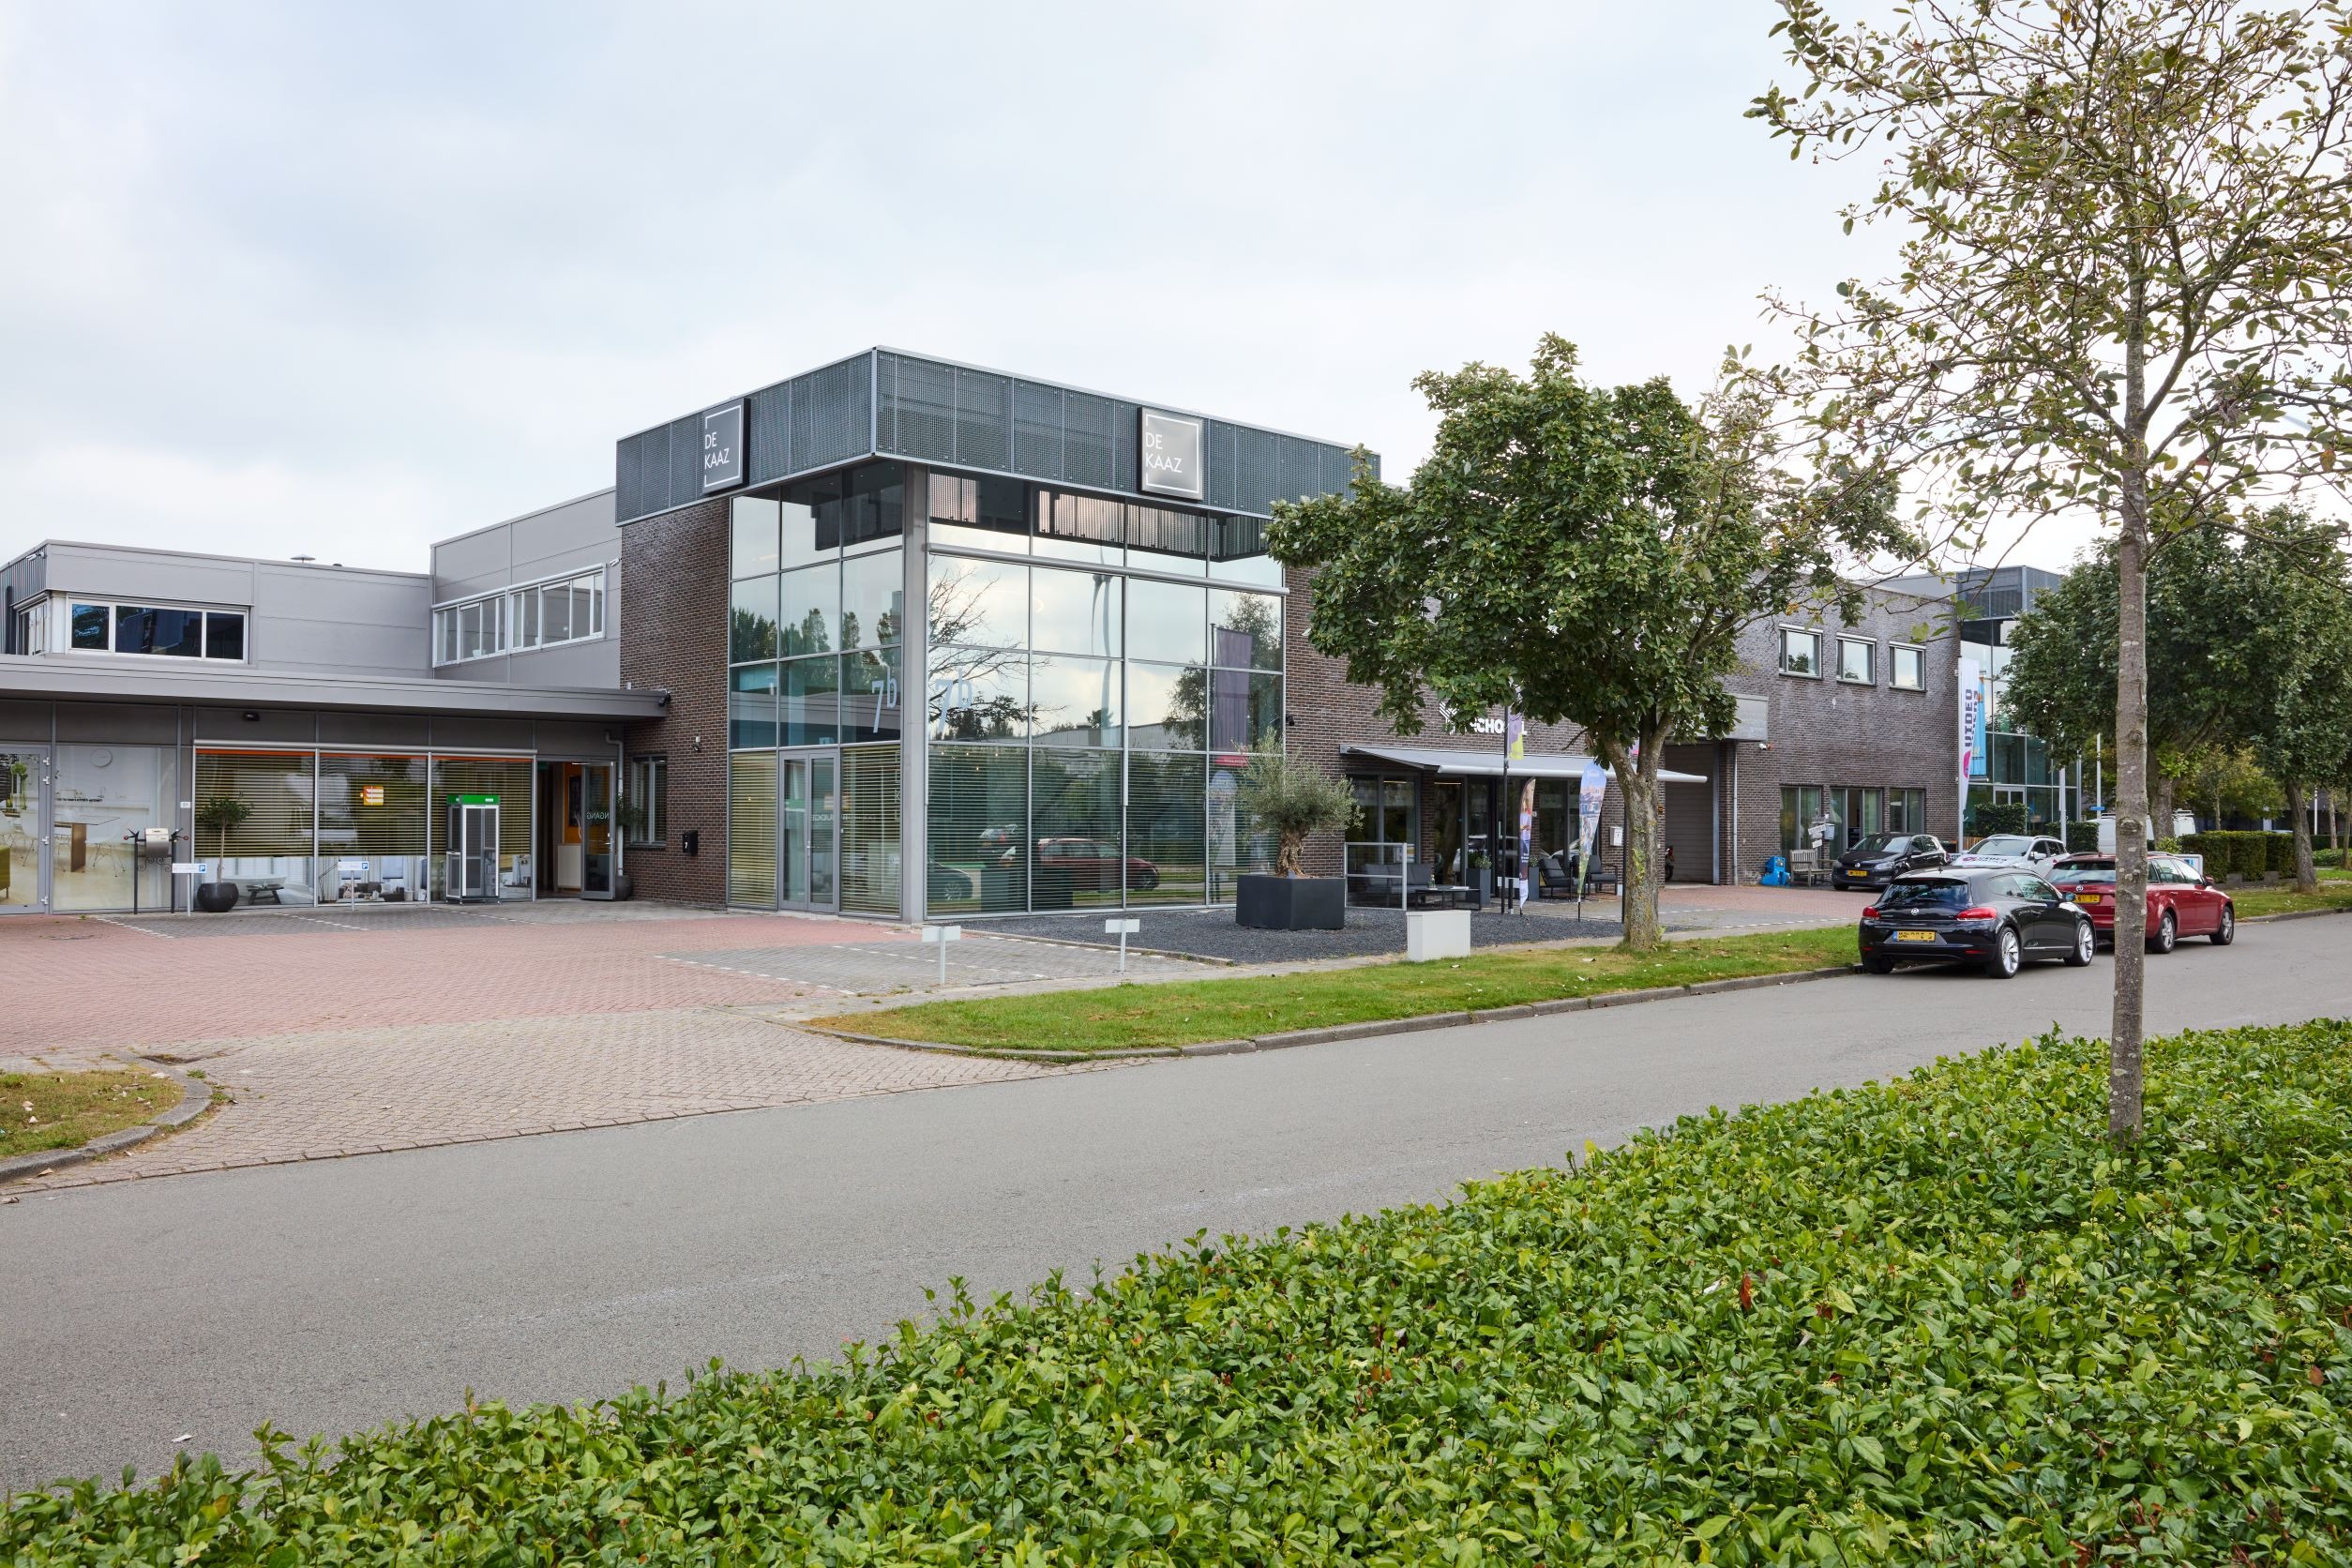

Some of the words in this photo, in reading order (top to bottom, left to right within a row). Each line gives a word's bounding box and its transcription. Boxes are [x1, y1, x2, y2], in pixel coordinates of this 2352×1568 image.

[705, 431, 717, 449] DE
[1145, 431, 1163, 450] DE
[704, 447, 730, 469] KAAZ
[1145, 452, 1183, 474] KAAZ
